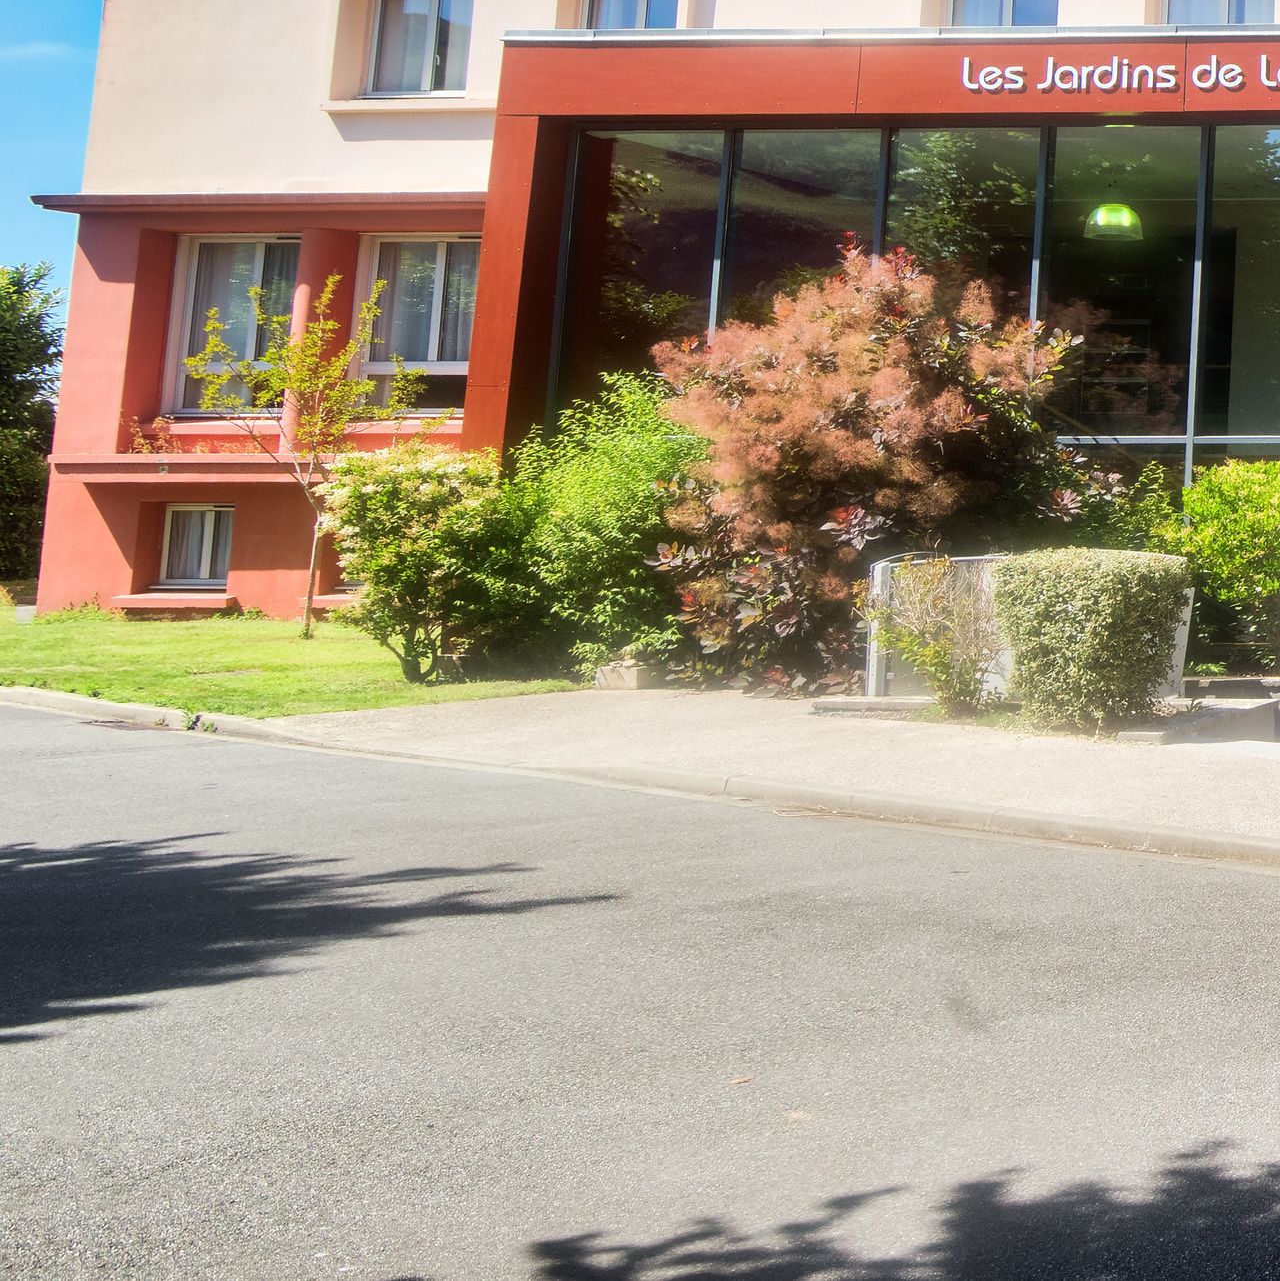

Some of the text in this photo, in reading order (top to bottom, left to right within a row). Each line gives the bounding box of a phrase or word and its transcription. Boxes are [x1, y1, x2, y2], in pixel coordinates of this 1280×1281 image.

[961, 55, 1024, 90] Les
[1036, 55, 1176, 90] Jardins
[1191, 54, 1244, 89] de
